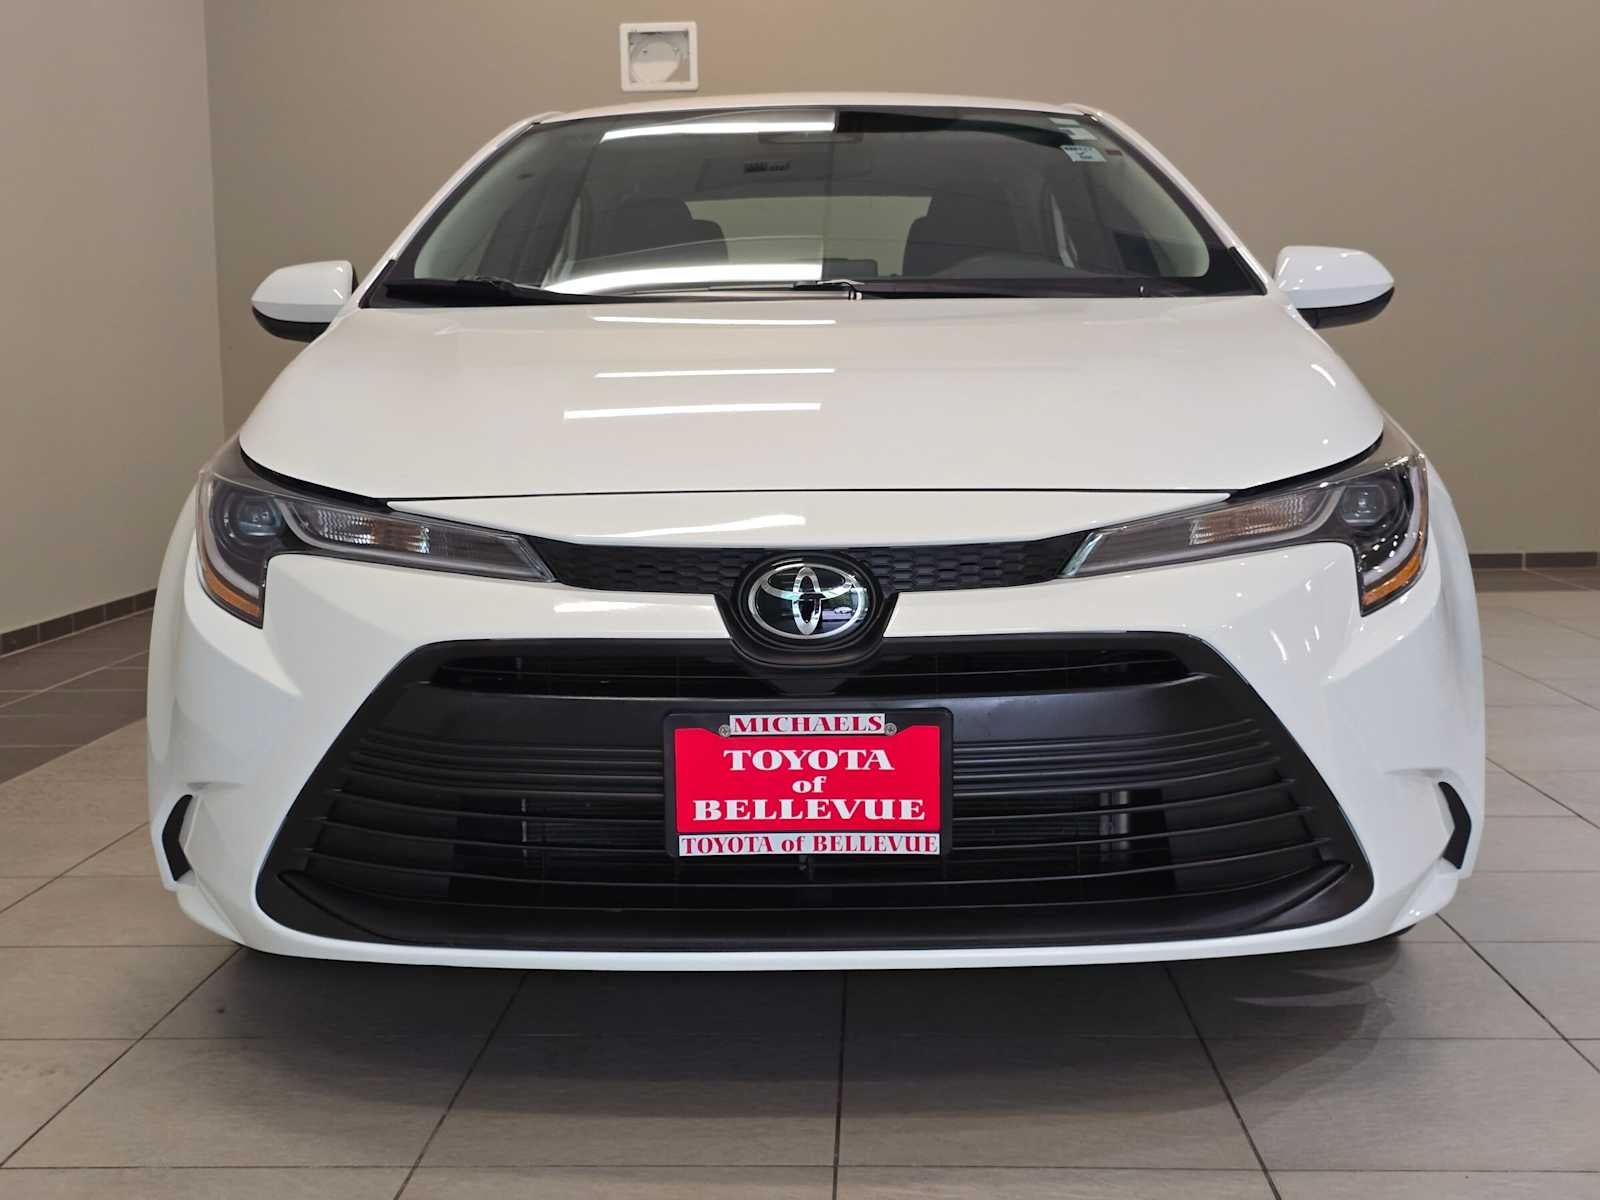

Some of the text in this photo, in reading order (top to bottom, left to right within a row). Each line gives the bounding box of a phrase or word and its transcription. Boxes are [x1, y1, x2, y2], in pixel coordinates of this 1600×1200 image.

[734, 715, 882, 732] MICHAELS
[723, 749, 895, 771] TOYOTA
[791, 775, 827, 793] of
[692, 799, 926, 821] BELLEVUE
[681, 834, 937, 855] TOYOTA of BELLEVUE
